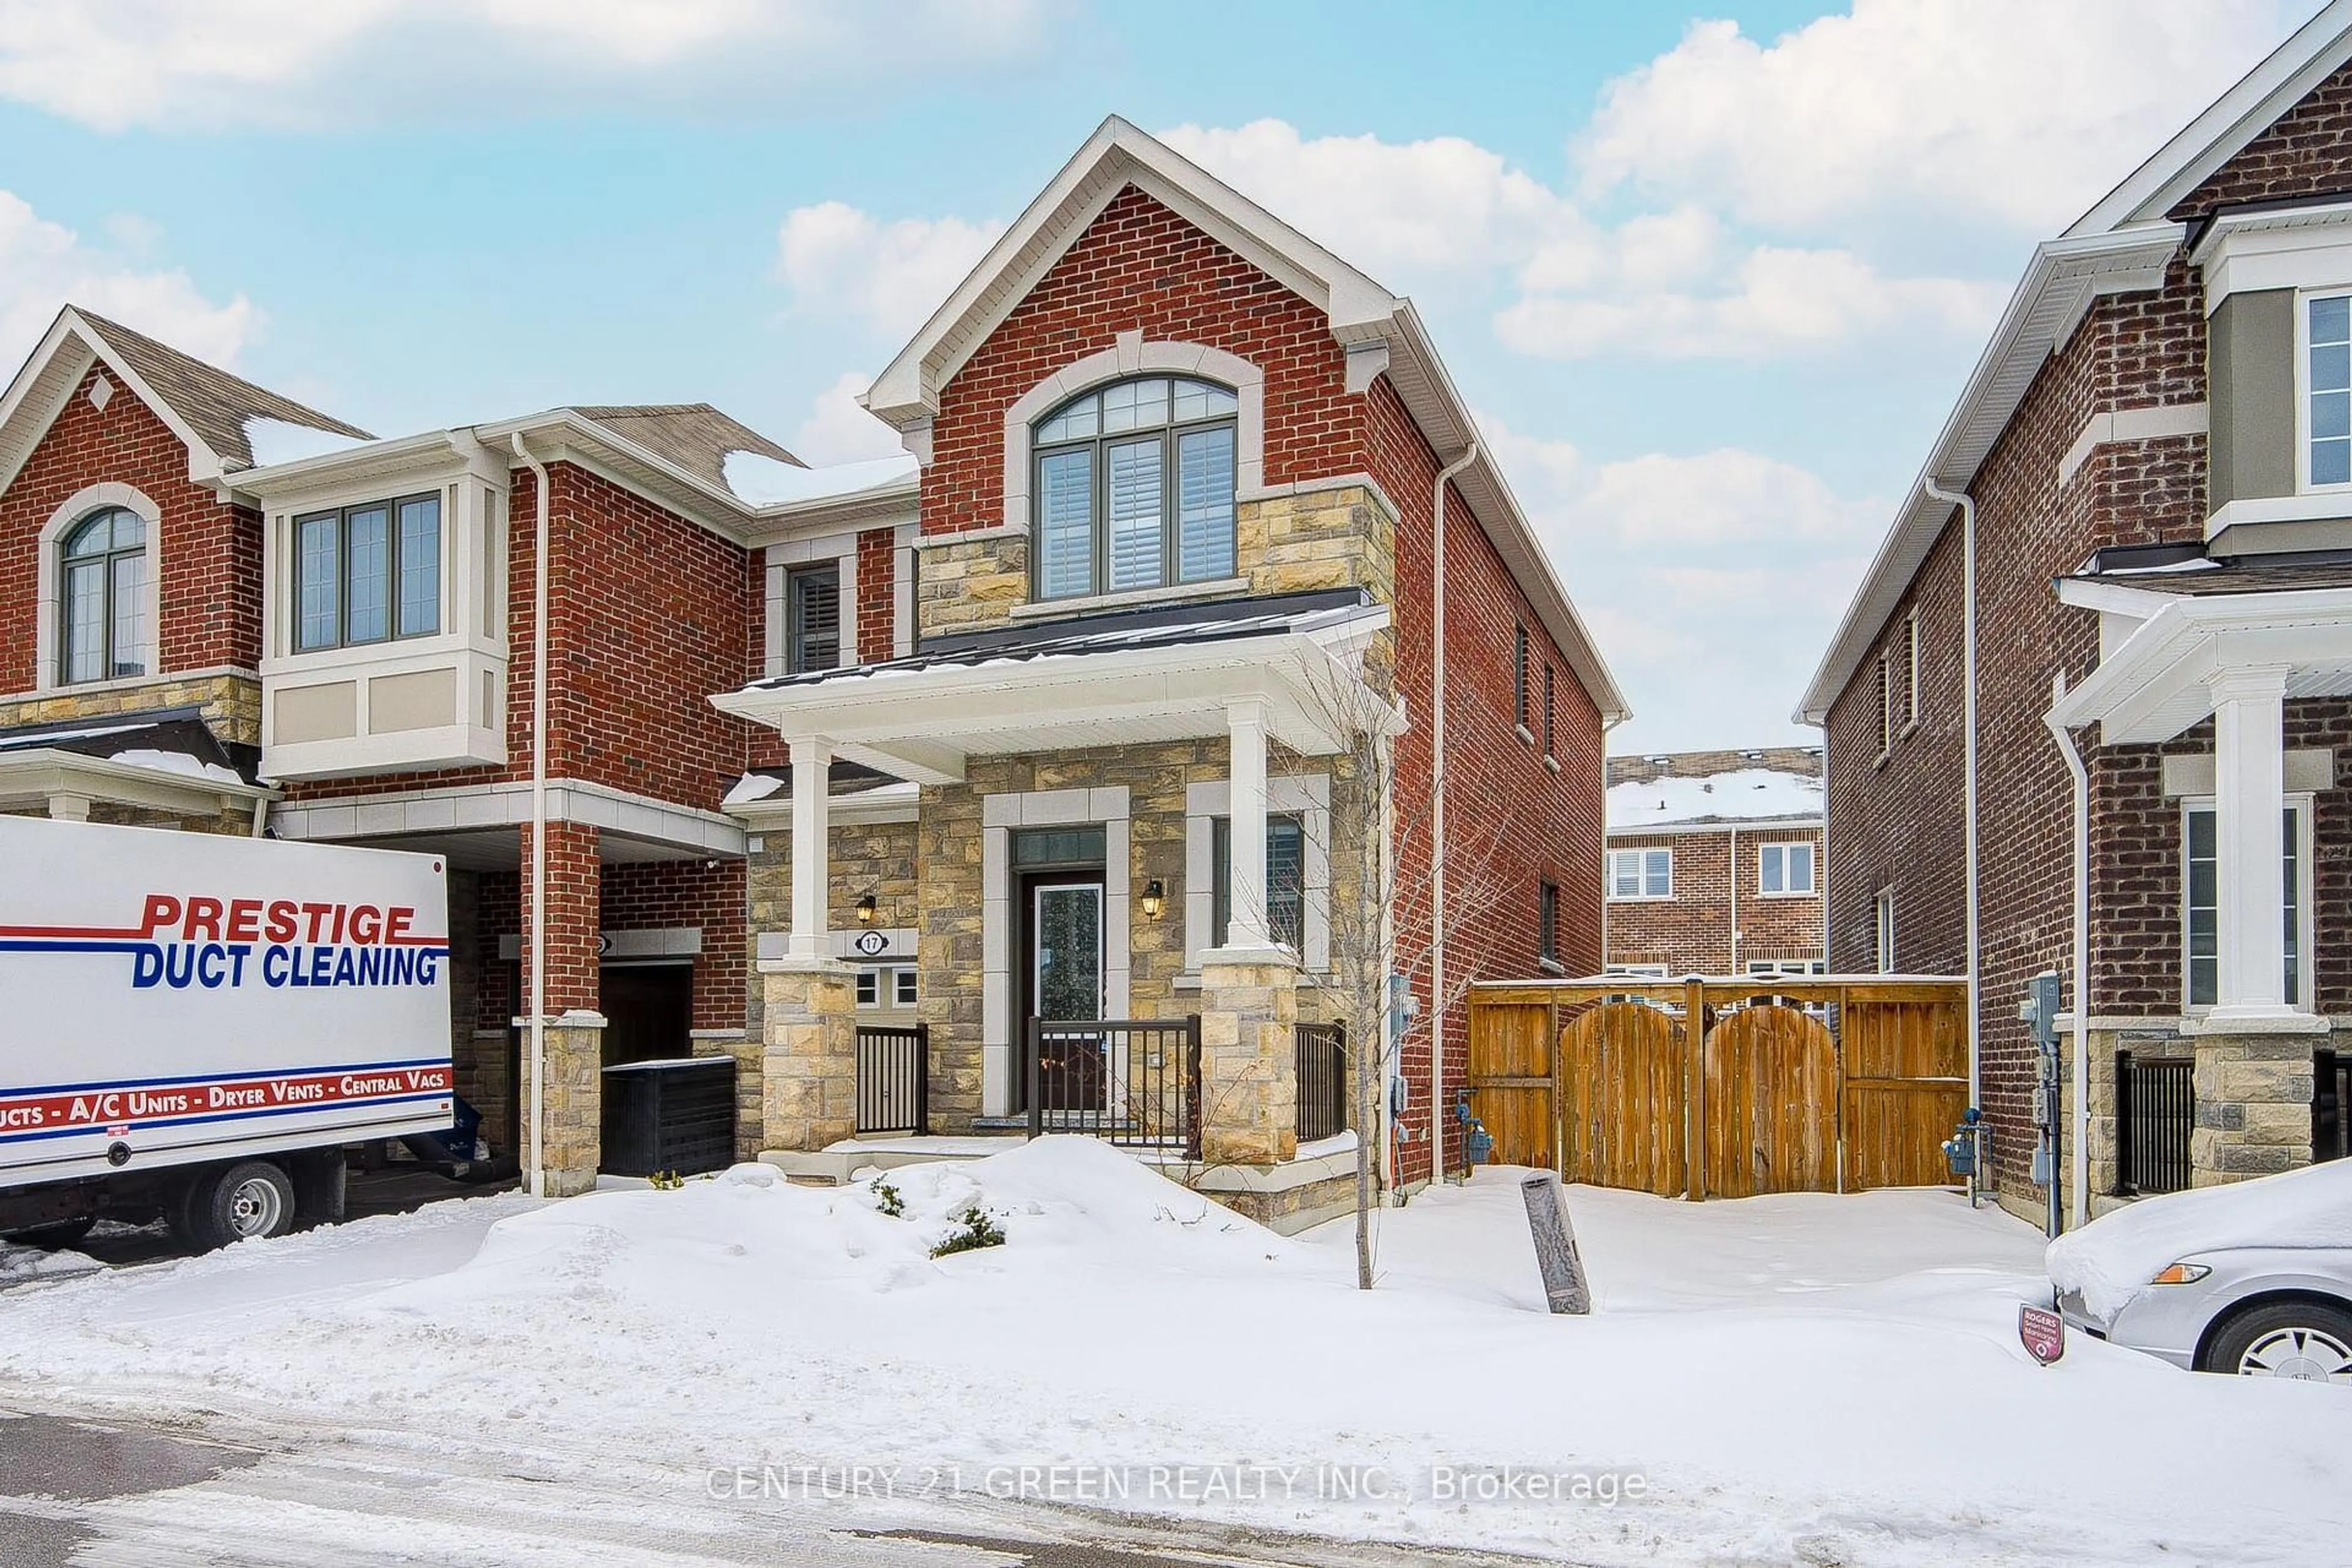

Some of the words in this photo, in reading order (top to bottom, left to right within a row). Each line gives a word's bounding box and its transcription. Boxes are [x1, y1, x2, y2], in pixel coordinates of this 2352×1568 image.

[138, 894, 415, 946] PRESTIGE
[132, 943, 251, 989] DUCT
[263, 944, 437, 988] CLEANING
[865, 937, 878, 950] 17
[69, 1093, 120, 1123] A/C
[128, 1092, 188, 1115] UNITS
[209, 1086, 265, 1108] DRYER
[271, 1081, 323, 1102] VENTS
[341, 1076, 402, 1096] CENTRAL
[407, 1071, 444, 1089] VACS
[2024, 1311, 2057, 1328] ROGERS
